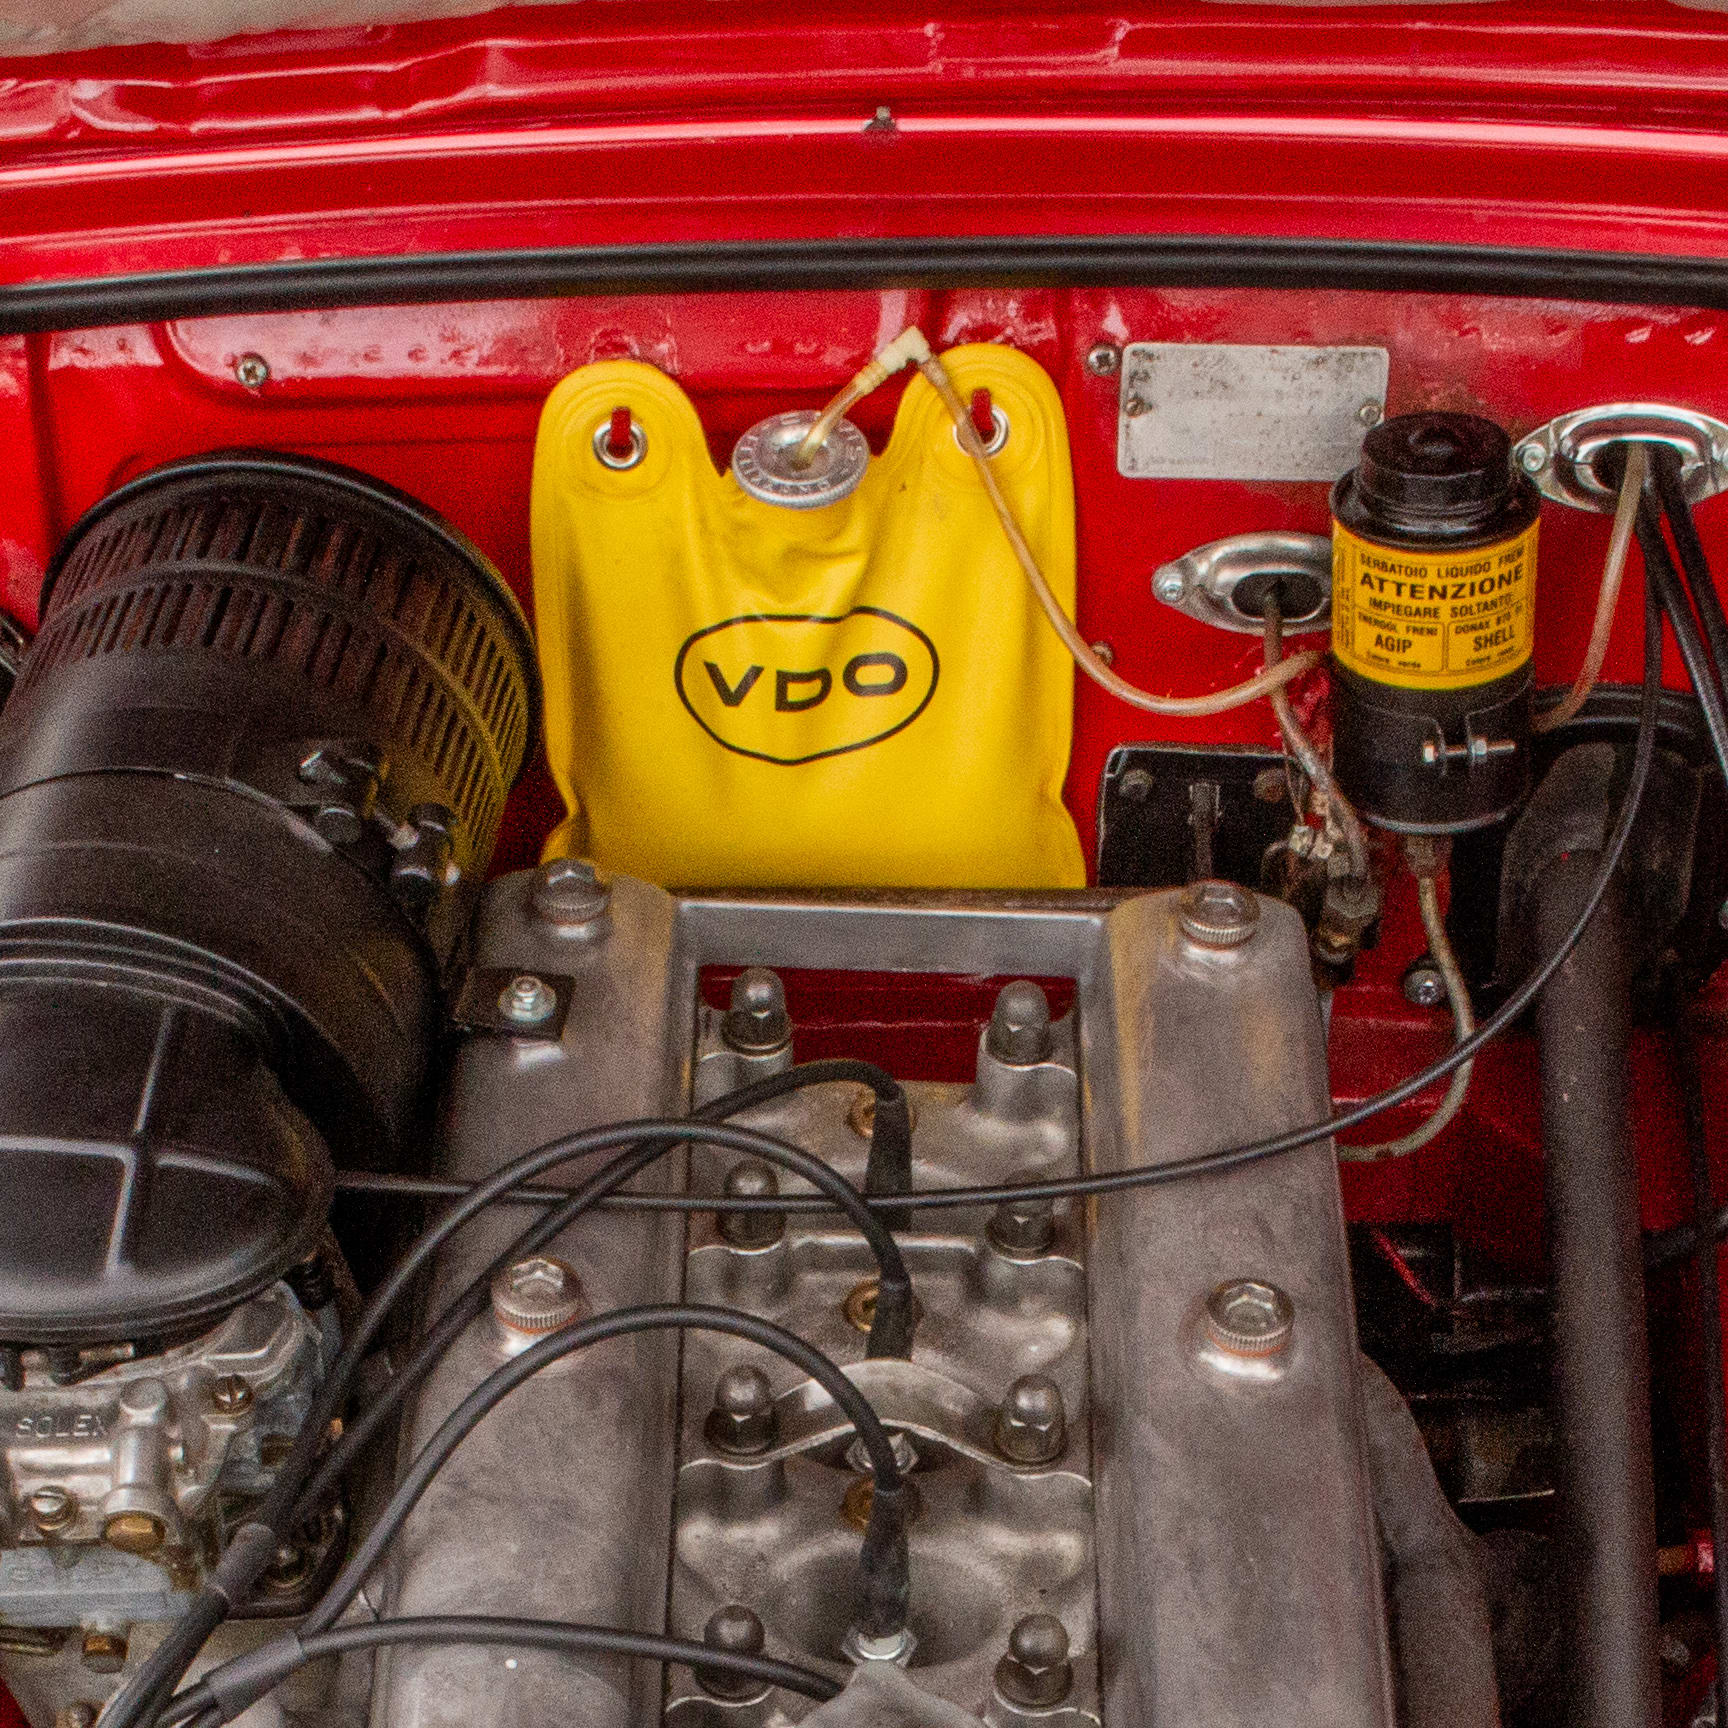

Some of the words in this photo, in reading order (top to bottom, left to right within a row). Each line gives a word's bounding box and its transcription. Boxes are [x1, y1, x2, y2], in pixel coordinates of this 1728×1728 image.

[1359, 552, 1428, 579] SERBATOIO
[1437, 561, 1492, 579] LIQUIDO
[1360, 563, 1524, 600] ATTENZIONE
[1369, 597, 1440, 619] IMPIEGARE
[1375, 634, 1412, 653] AGIP
[1473, 625, 1515, 651] SHELL
[704, 651, 908, 713] VDO
[15, 1414, 108, 1438] SOLEX
